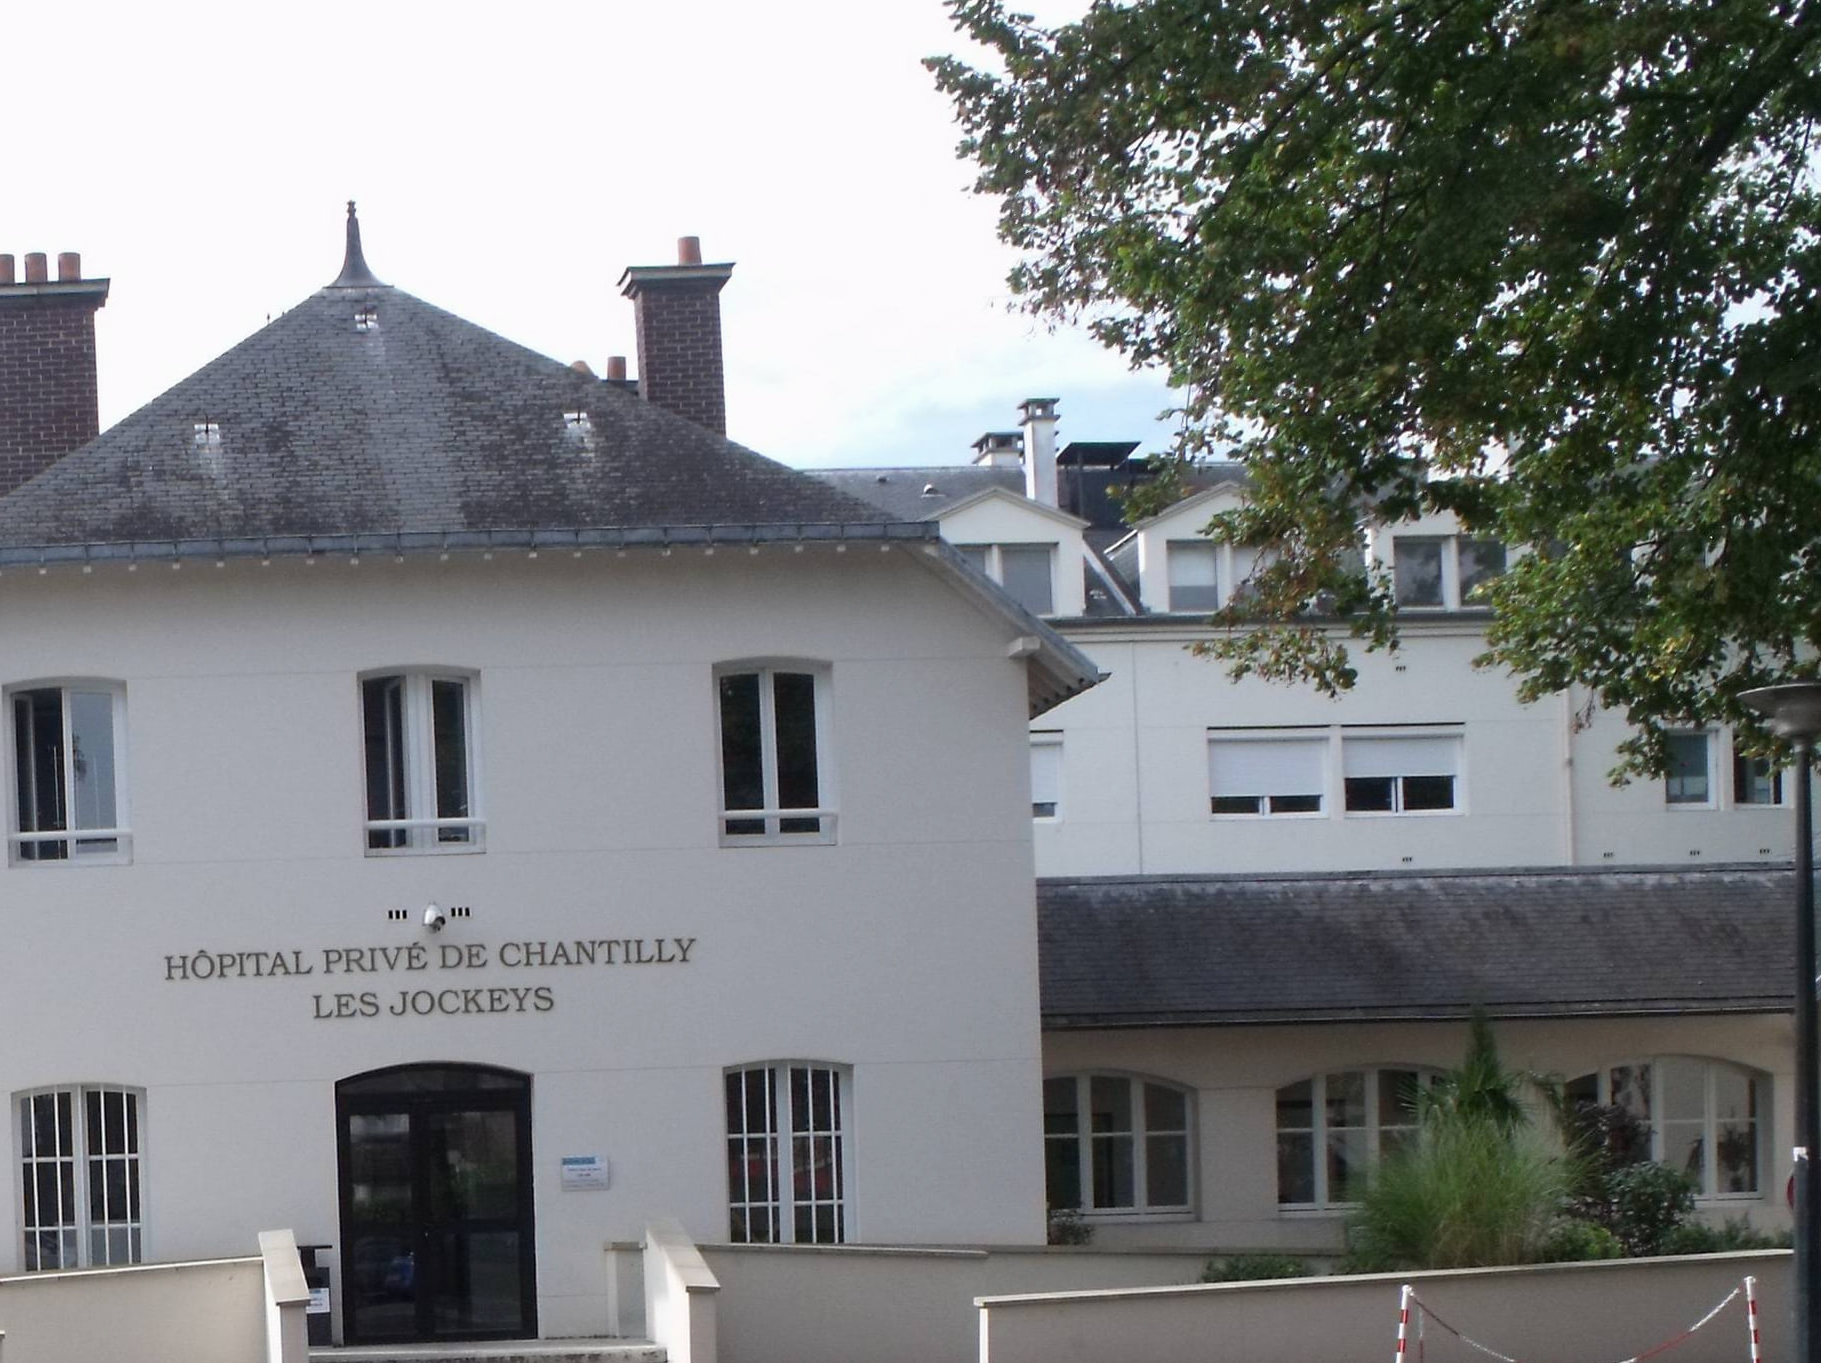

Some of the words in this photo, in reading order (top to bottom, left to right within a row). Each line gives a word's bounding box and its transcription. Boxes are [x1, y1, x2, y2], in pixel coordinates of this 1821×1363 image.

[164, 949, 313, 981] HÔPITAL
[323, 942, 428, 975] PRIVÉ
[439, 944, 488, 969] DE
[499, 938, 696, 967] CHANTILLY
[313, 993, 380, 1020] LES
[389, 987, 555, 1016] JOCKEYS
